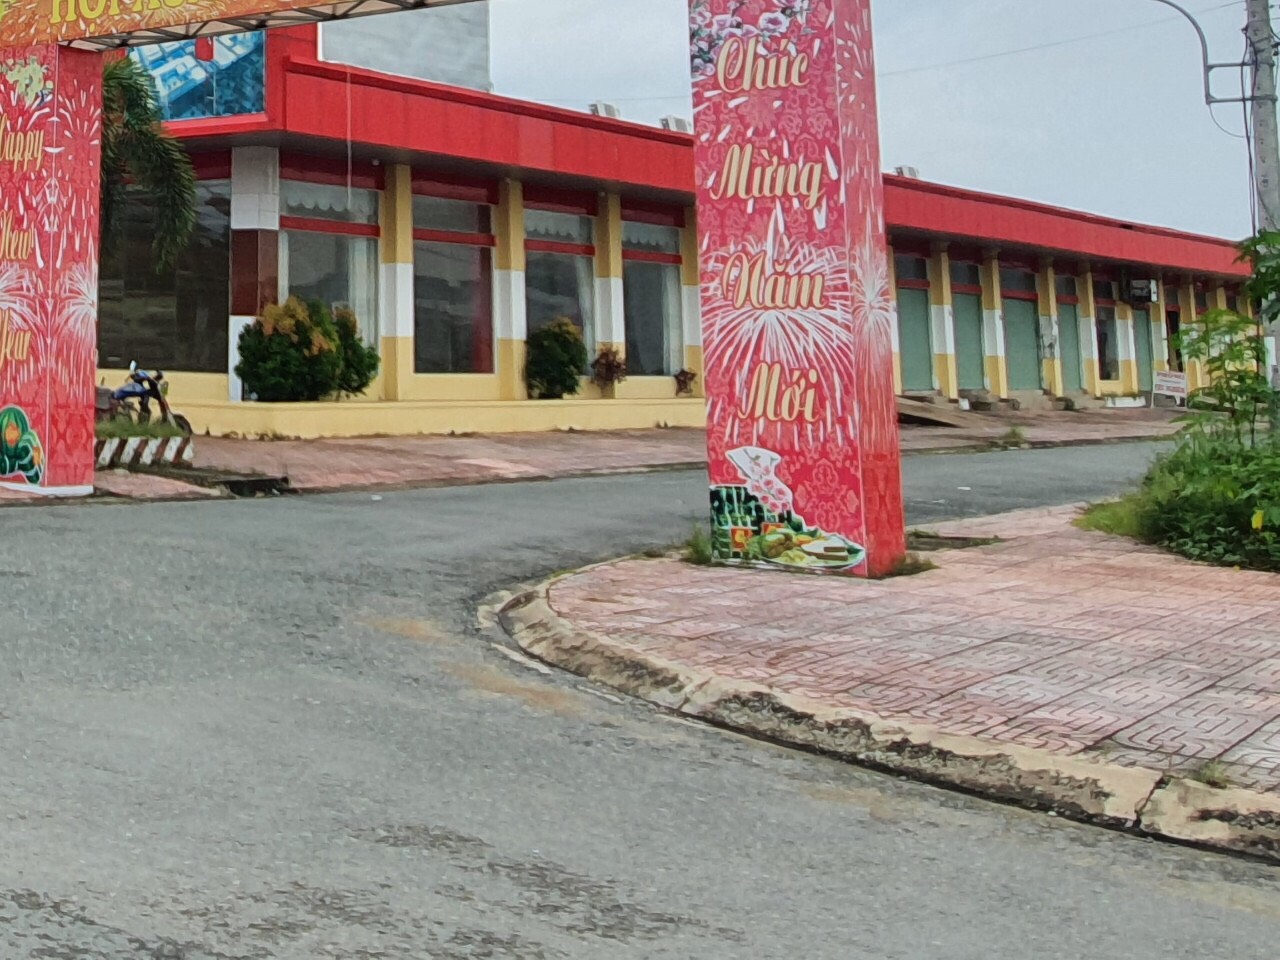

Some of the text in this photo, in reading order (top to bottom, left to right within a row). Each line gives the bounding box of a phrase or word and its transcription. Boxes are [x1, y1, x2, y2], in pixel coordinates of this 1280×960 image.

[717, 37, 811, 93] Chúc
[709, 143, 827, 210] Mừng
[722, 251, 828, 310] Năm
[738, 362, 821, 422] Mới
